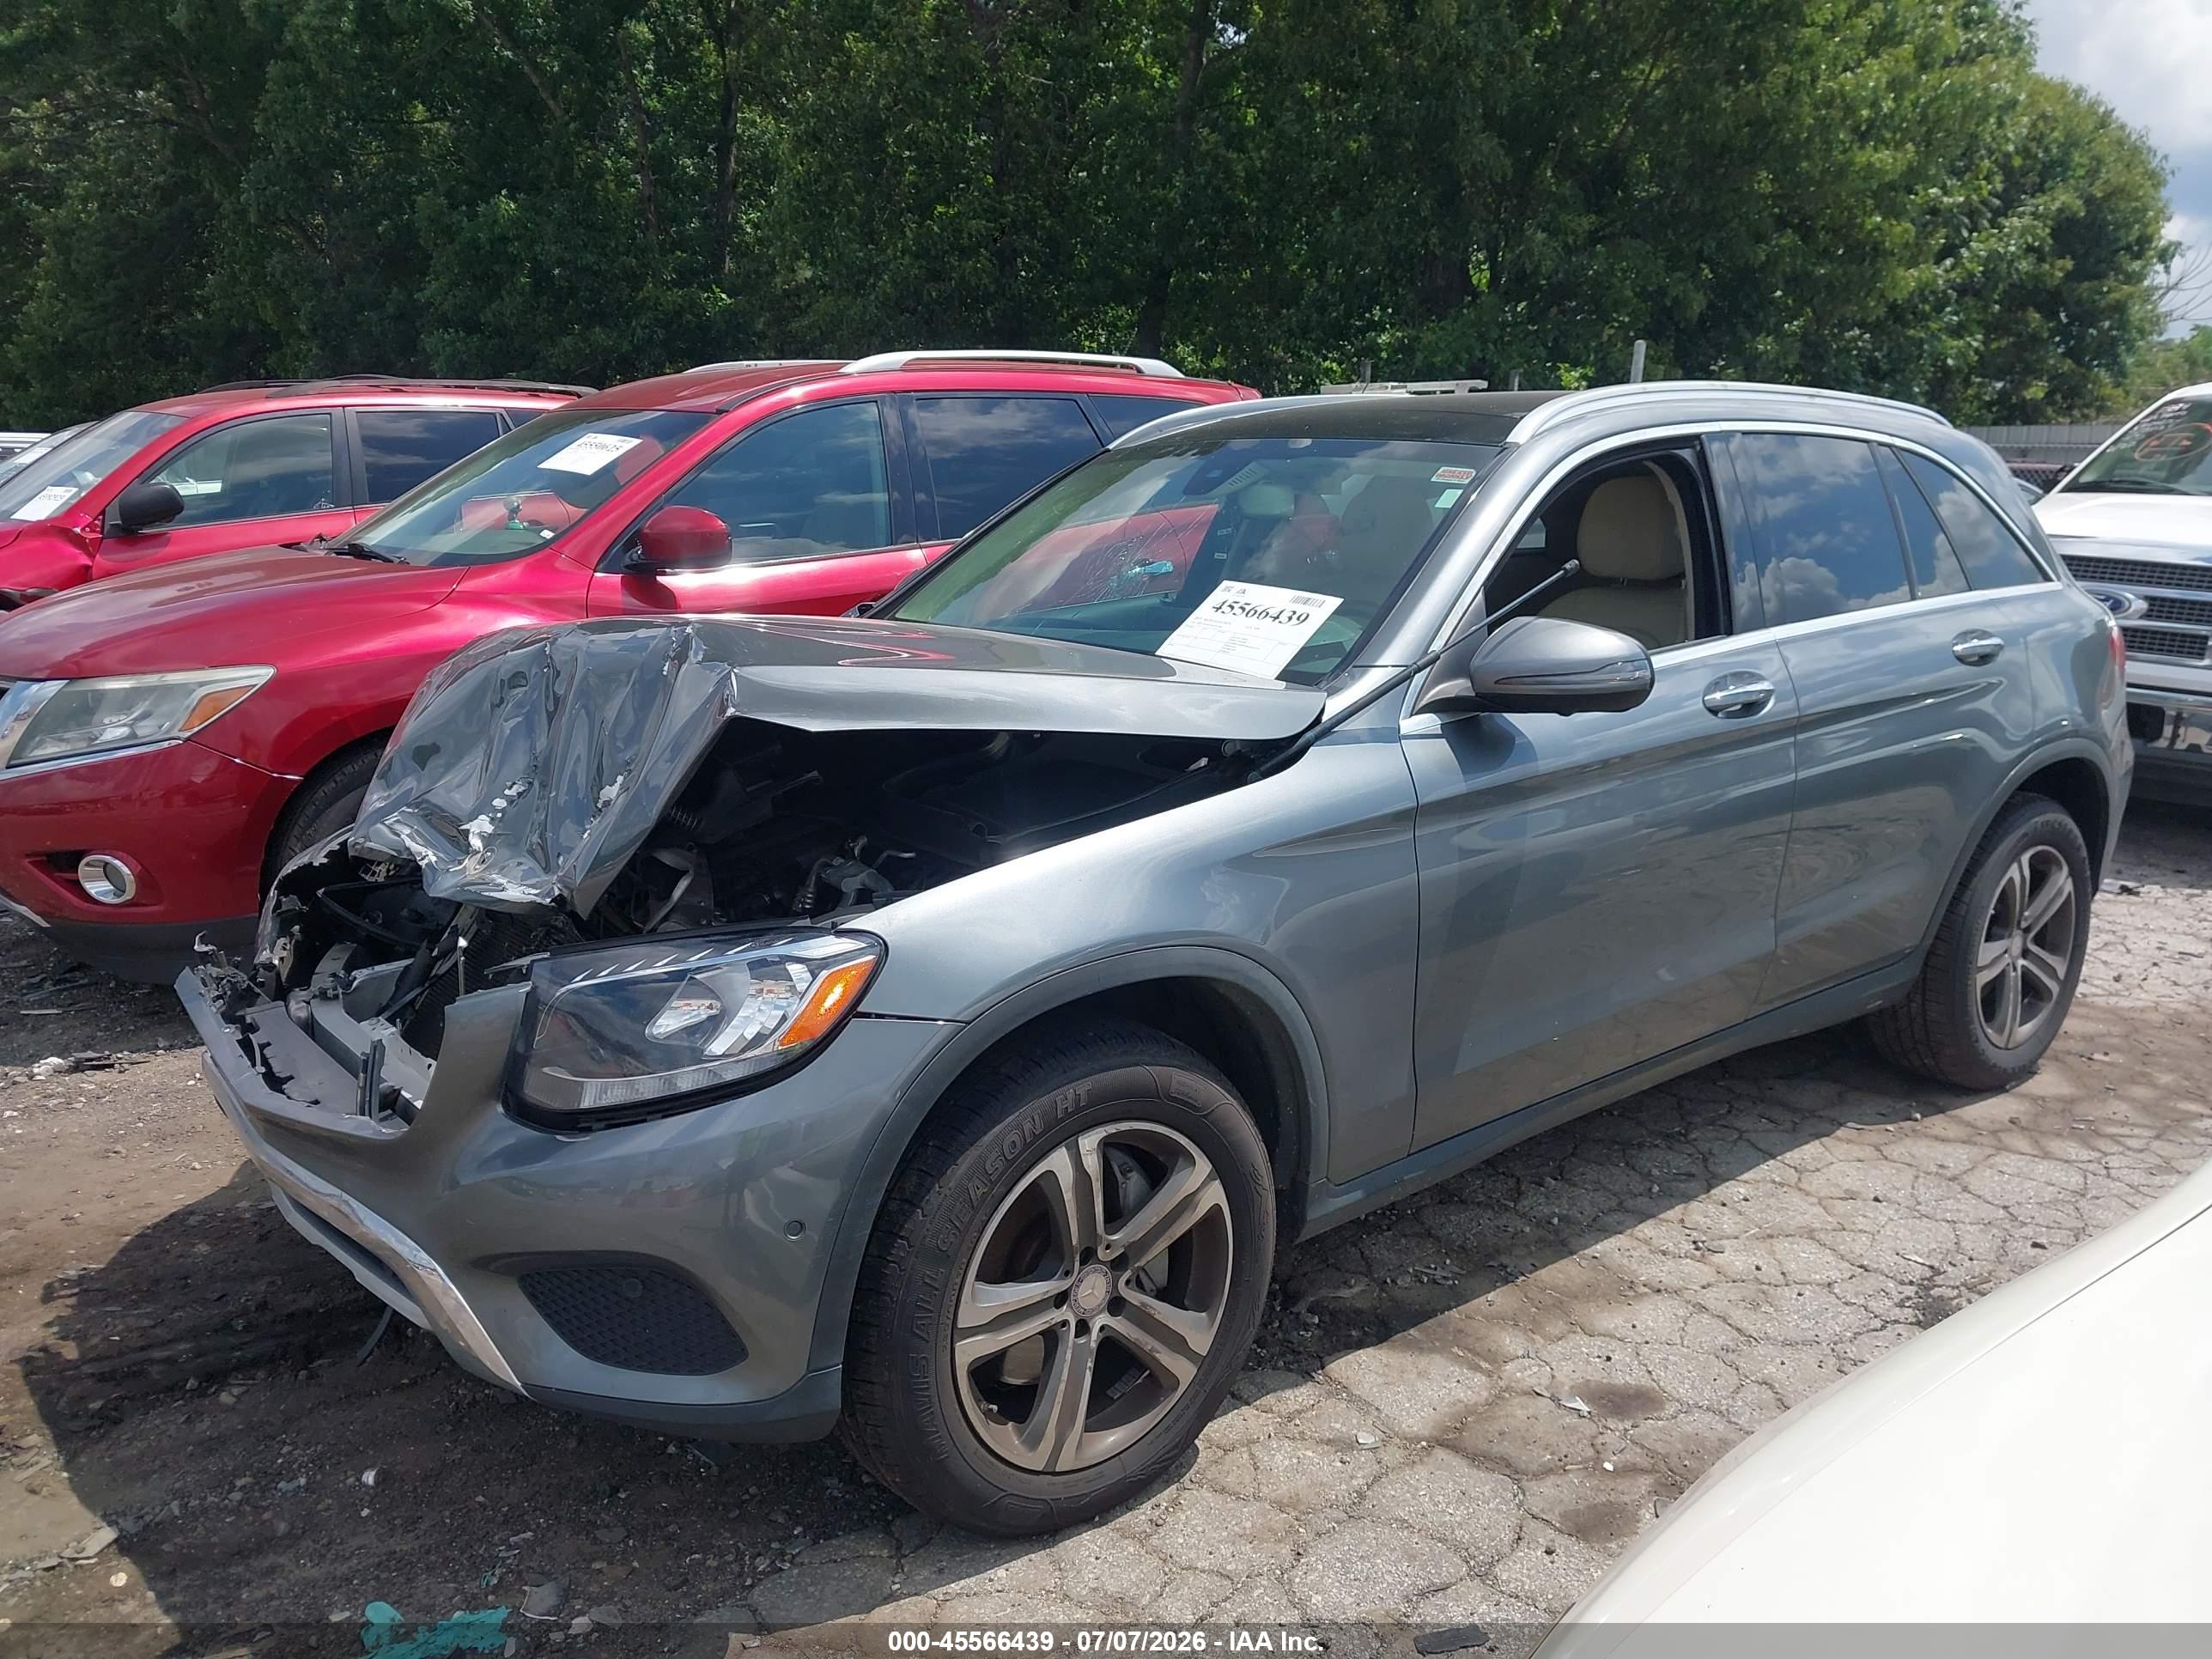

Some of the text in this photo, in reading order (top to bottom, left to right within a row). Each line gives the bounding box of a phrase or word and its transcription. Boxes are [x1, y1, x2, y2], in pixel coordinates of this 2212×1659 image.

[1212, 599, 1310, 627] 45566439
[937, 1113, 1045, 1253] SEASON
[1055, 1082, 1093, 1119] HT
